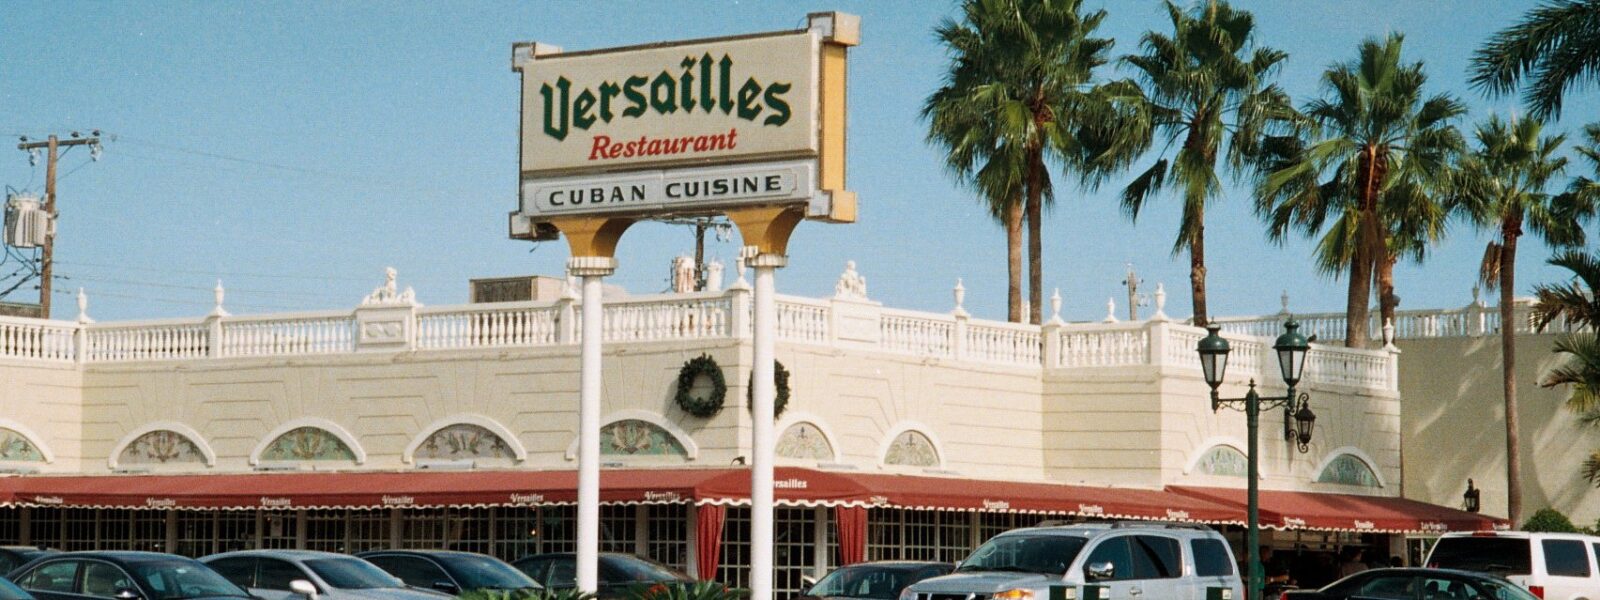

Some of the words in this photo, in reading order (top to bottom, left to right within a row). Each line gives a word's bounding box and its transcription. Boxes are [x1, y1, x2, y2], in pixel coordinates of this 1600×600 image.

[588, 128, 738, 160] Restaurant
[549, 184, 646, 206] CUBAN
[665, 175, 782, 198] CUISINE
[774, 478, 807, 488] rsailles
